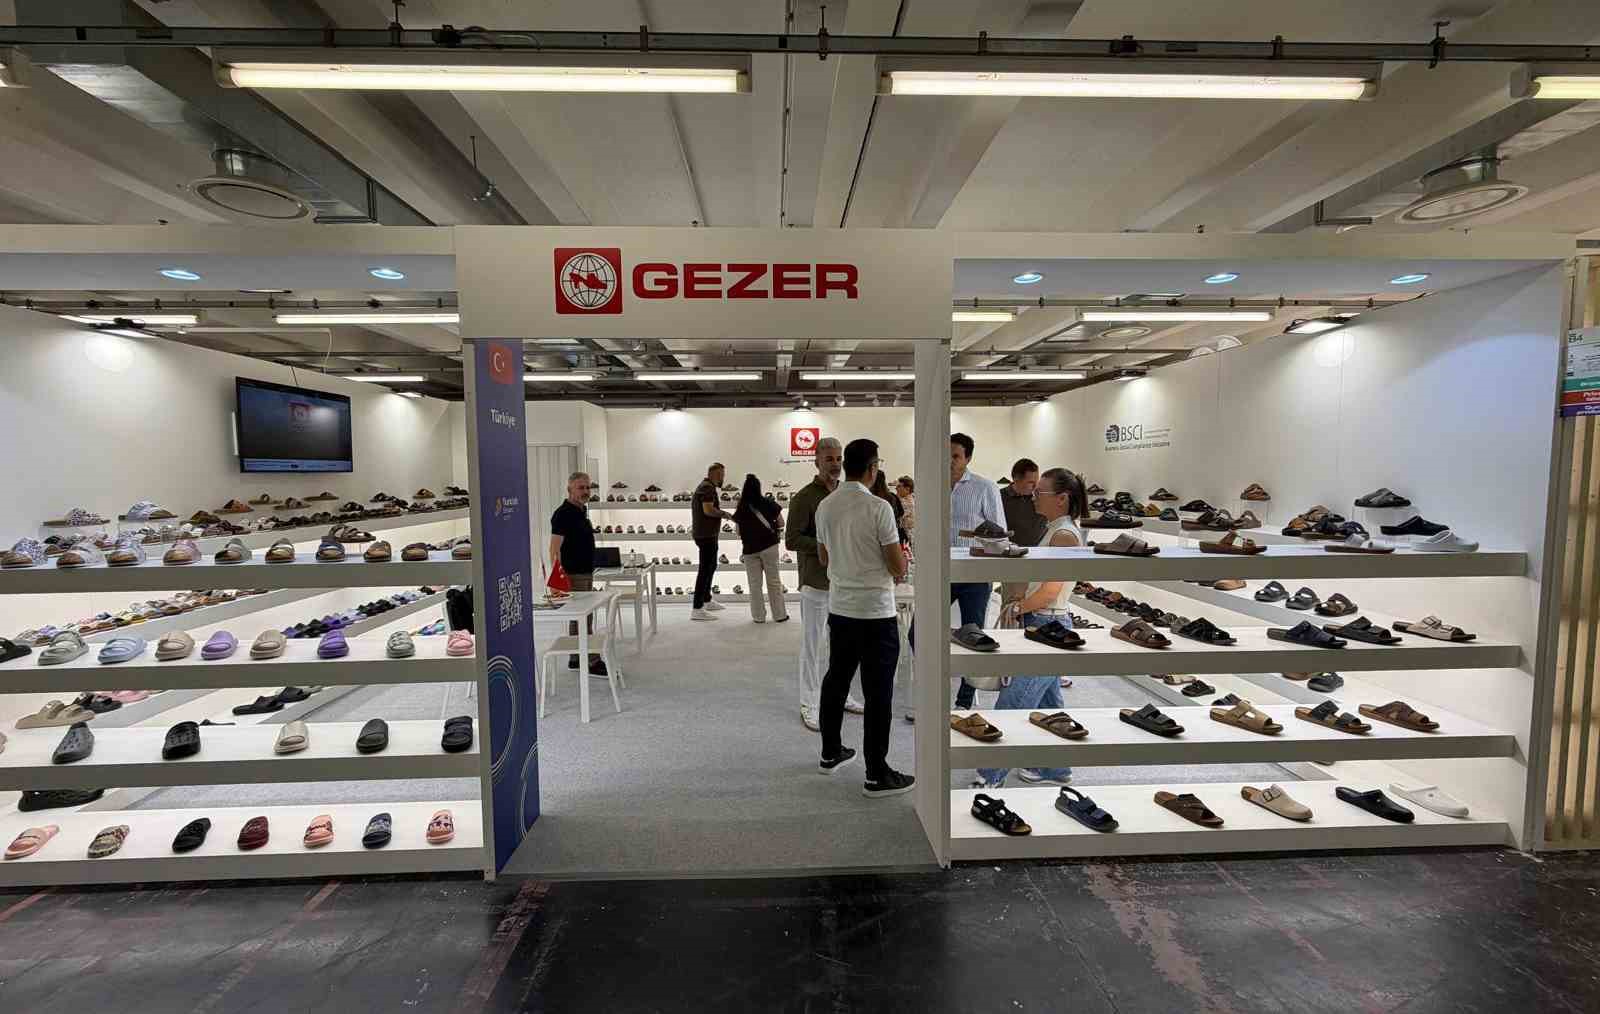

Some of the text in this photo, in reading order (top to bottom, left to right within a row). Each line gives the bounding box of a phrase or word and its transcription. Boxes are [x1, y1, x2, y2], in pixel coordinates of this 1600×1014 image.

[632, 263, 858, 299] GEZER
[490, 408, 516, 428] Türkiye
[1121, 424, 1143, 441] BSCI
